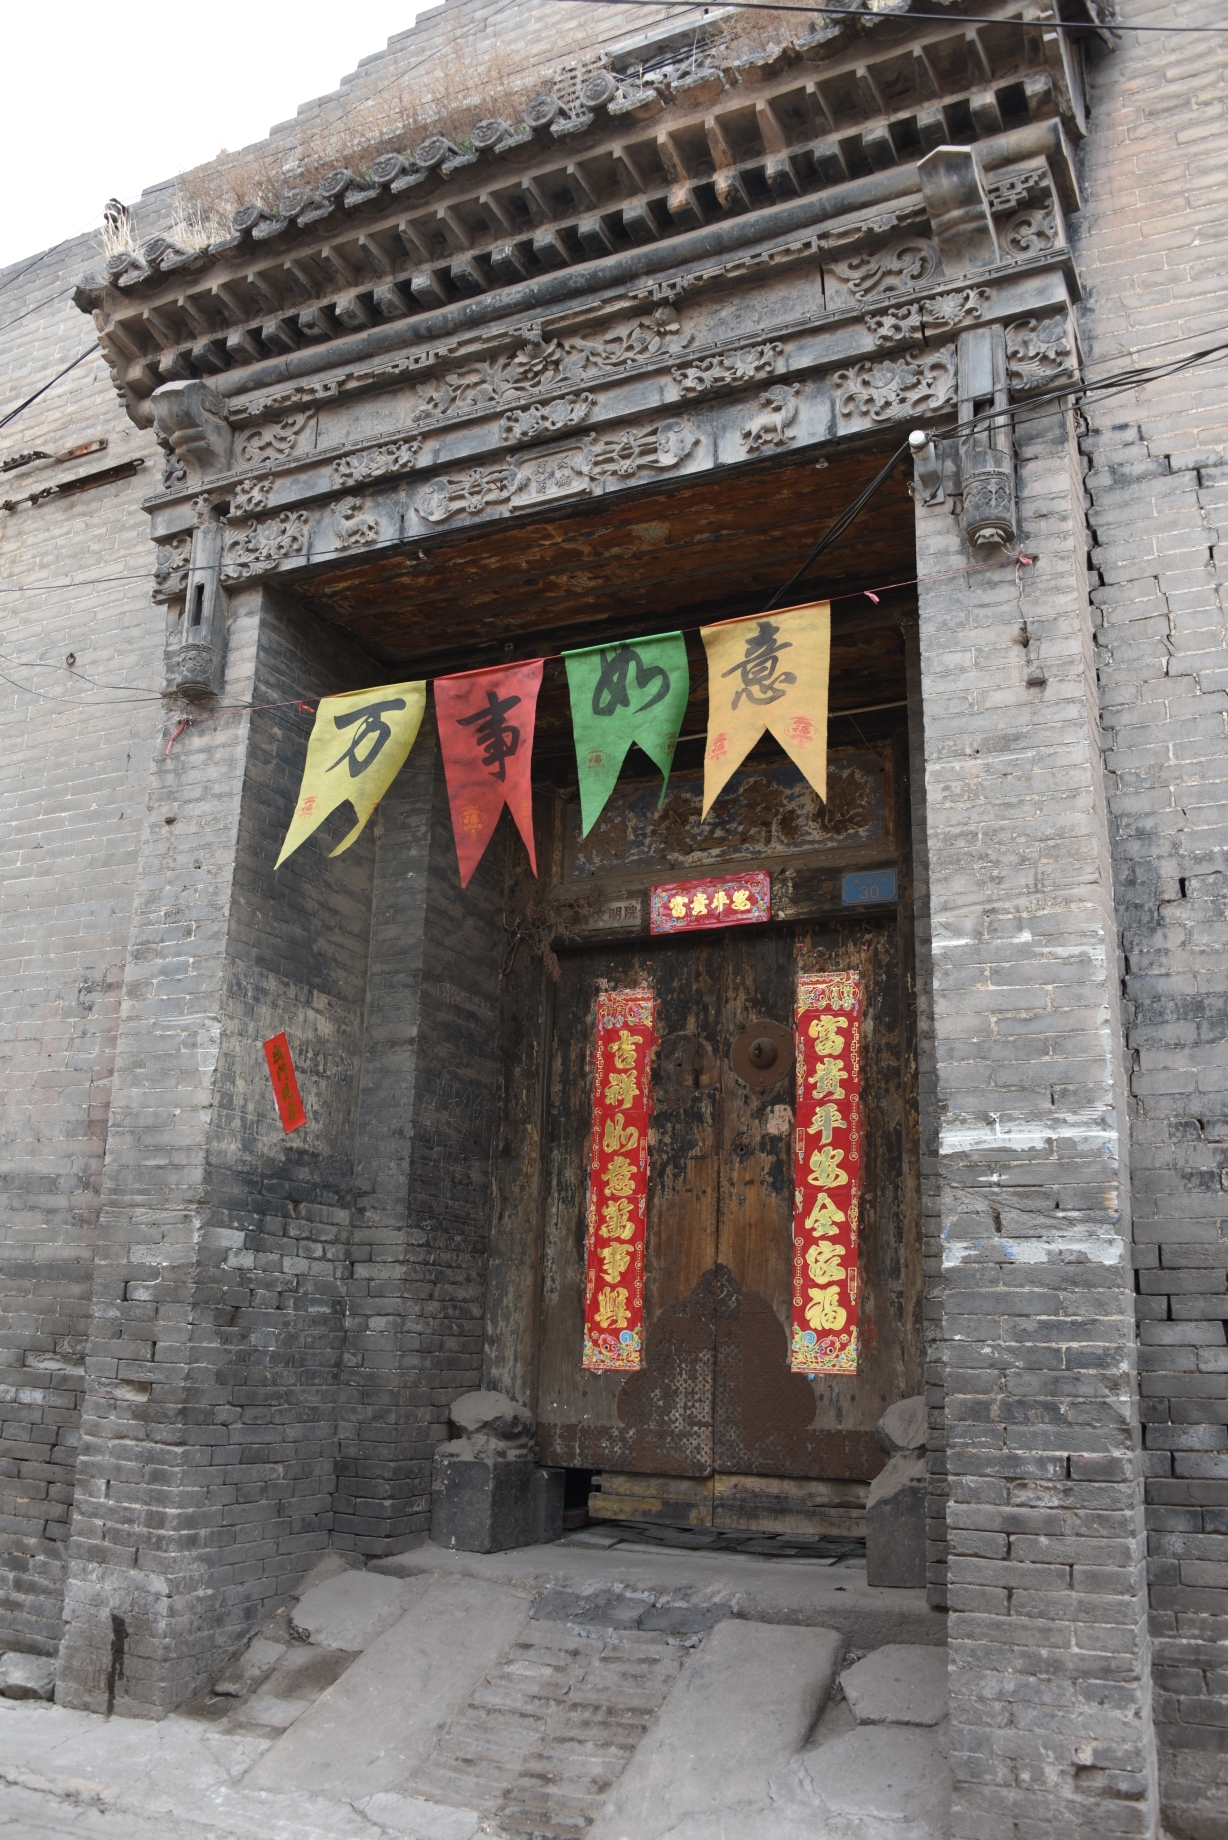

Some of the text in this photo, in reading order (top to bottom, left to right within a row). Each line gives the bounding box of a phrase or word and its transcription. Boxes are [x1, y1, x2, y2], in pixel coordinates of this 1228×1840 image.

[326, 621, 798, 783] 万 事 如 意
[860, 885, 879, 900] 30
[805, 1015, 849, 1331] 富貴平安全家福
